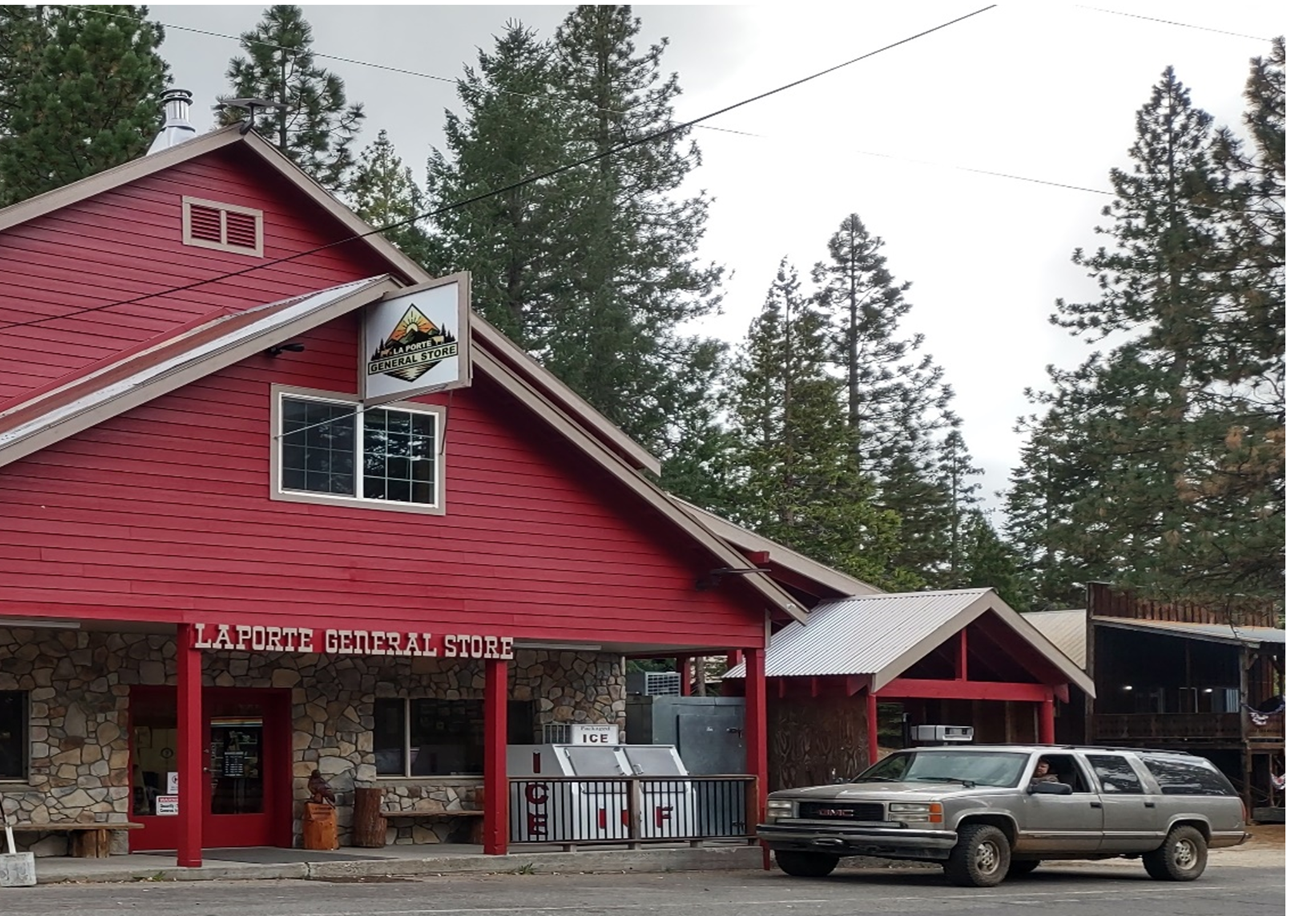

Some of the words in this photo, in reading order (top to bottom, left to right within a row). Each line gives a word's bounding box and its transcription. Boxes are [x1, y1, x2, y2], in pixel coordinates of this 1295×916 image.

[393, 347, 404, 355] LA
[405, 340, 432, 352] PORTE
[370, 353, 417, 373] GENERAL
[421, 345, 456, 361] STORE
[194, 623, 314, 652] LAPORTE
[325, 629, 437, 658] GENERAL
[444, 634, 514, 660] STORE
[582, 733, 609, 744] ICE
[818, 809, 854, 817] GMC
